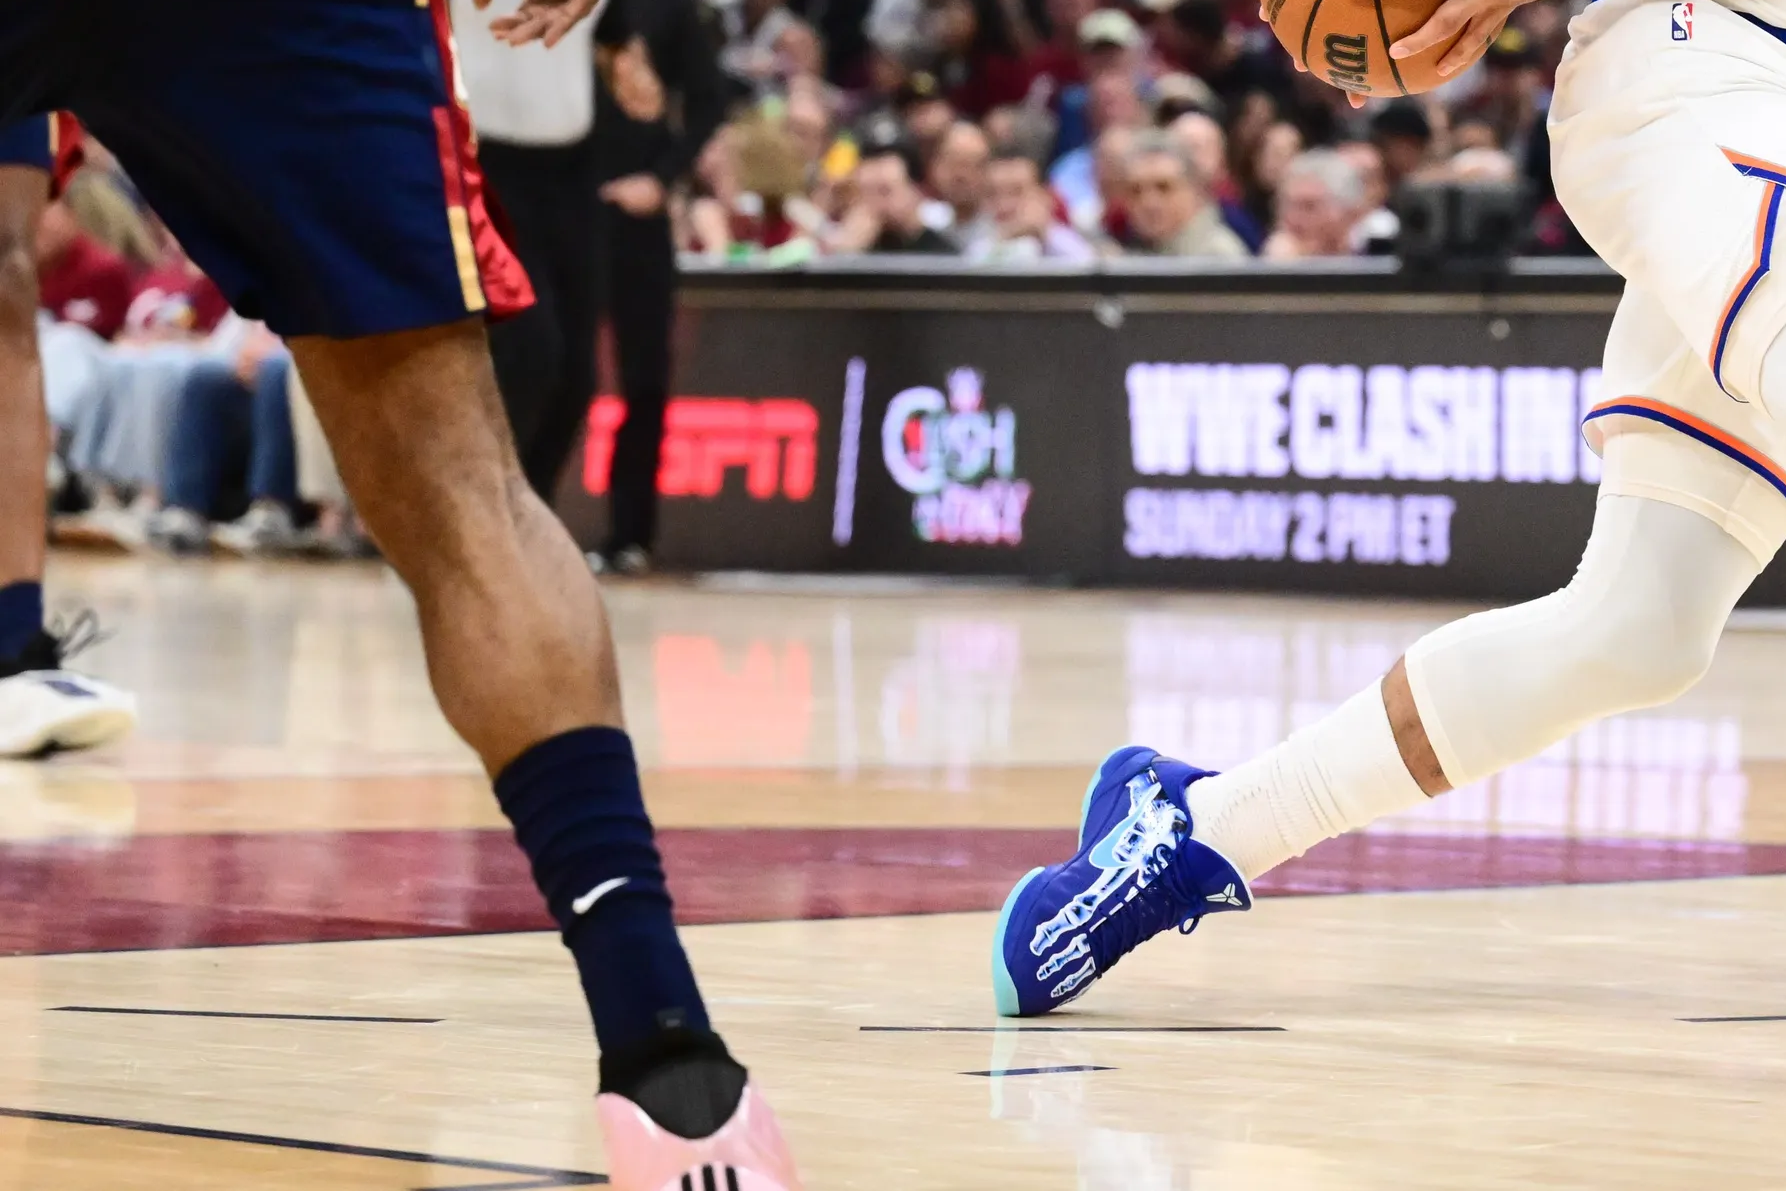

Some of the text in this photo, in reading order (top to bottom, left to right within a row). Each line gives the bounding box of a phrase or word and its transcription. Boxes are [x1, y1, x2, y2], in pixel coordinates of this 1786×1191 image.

[1126, 363, 1290, 477] WWE
[1291, 365, 1498, 480] CLASH
[1500, 367, 1578, 483] IN
[1125, 488, 1454, 564] SUNDAY 2 PM ET
